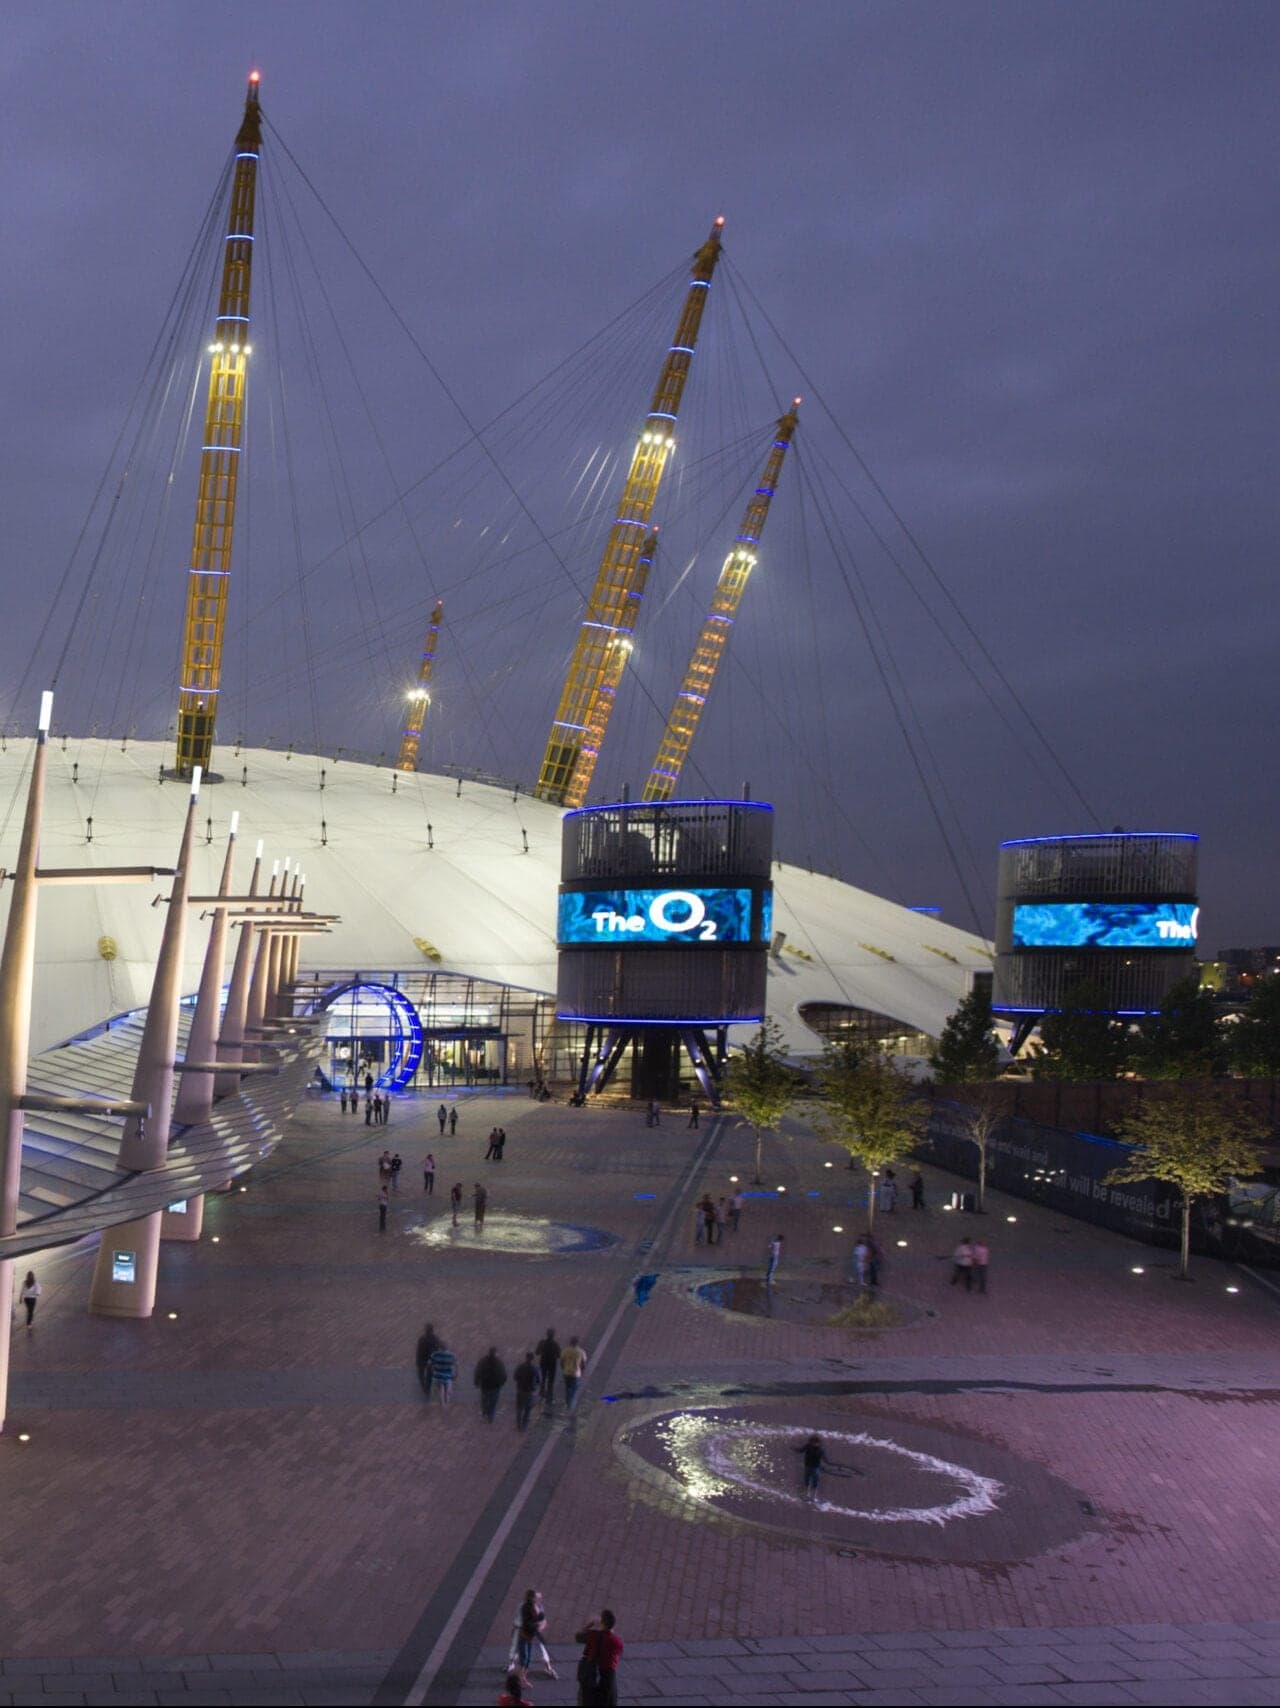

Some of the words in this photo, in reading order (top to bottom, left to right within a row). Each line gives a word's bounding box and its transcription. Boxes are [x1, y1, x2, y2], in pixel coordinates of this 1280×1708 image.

[592, 911, 645, 932] The
[1069, 1175, 1090, 1197] will
[1092, 1179, 1107, 1203] be
[1110, 1190, 1170, 1220] revealed
